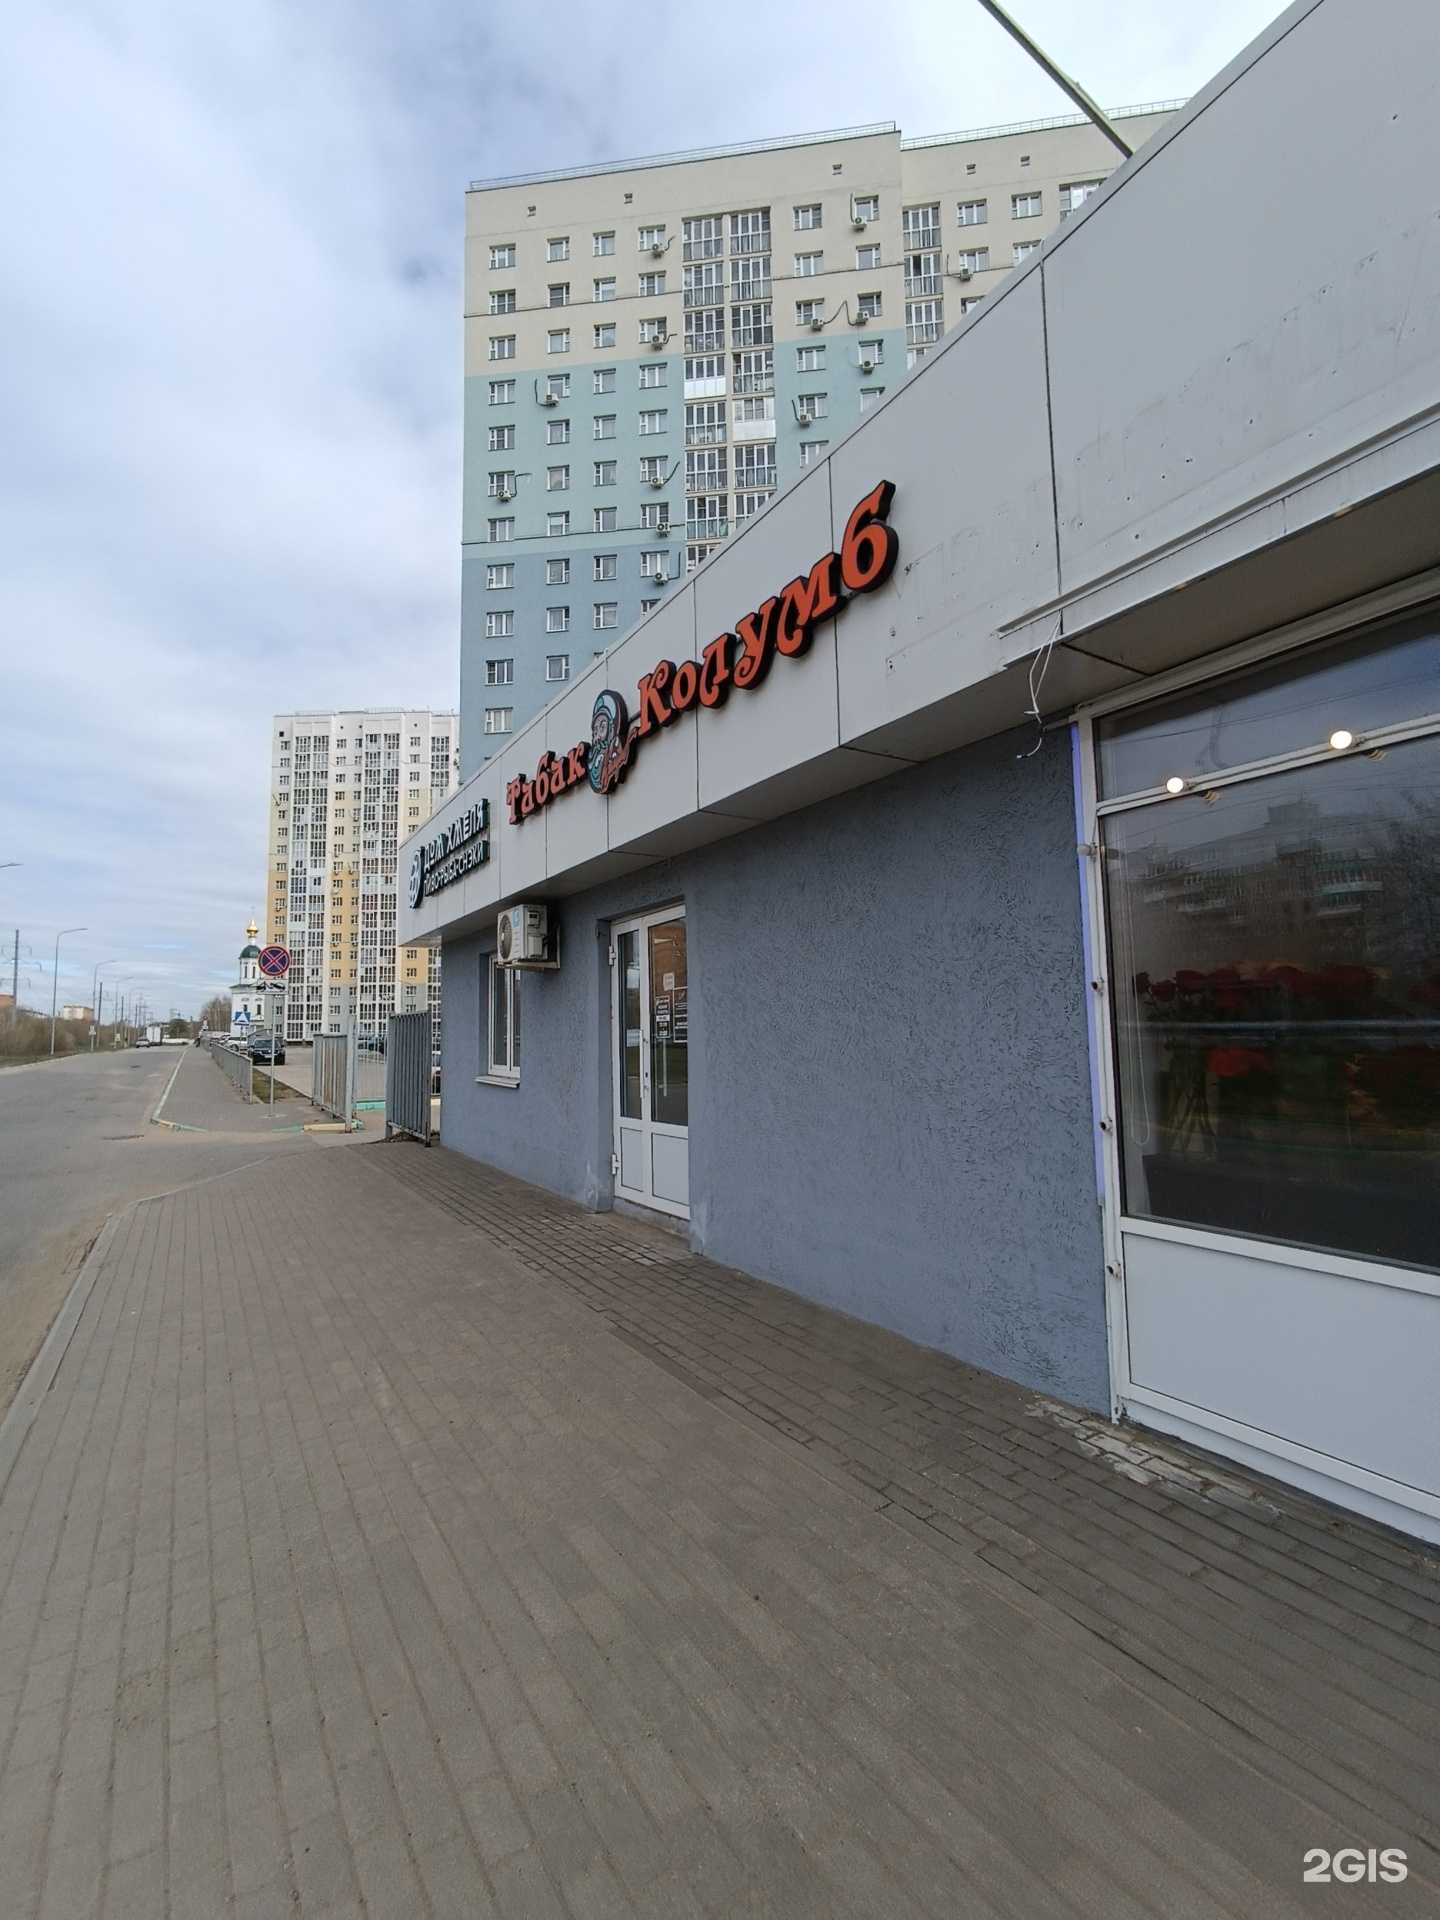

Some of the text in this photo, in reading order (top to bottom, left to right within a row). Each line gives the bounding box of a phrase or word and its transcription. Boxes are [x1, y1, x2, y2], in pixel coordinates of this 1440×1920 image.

[506, 479, 898, 825] Табак Колумб
[422, 798, 488, 874] ДОМ ХМЕЛЯ
